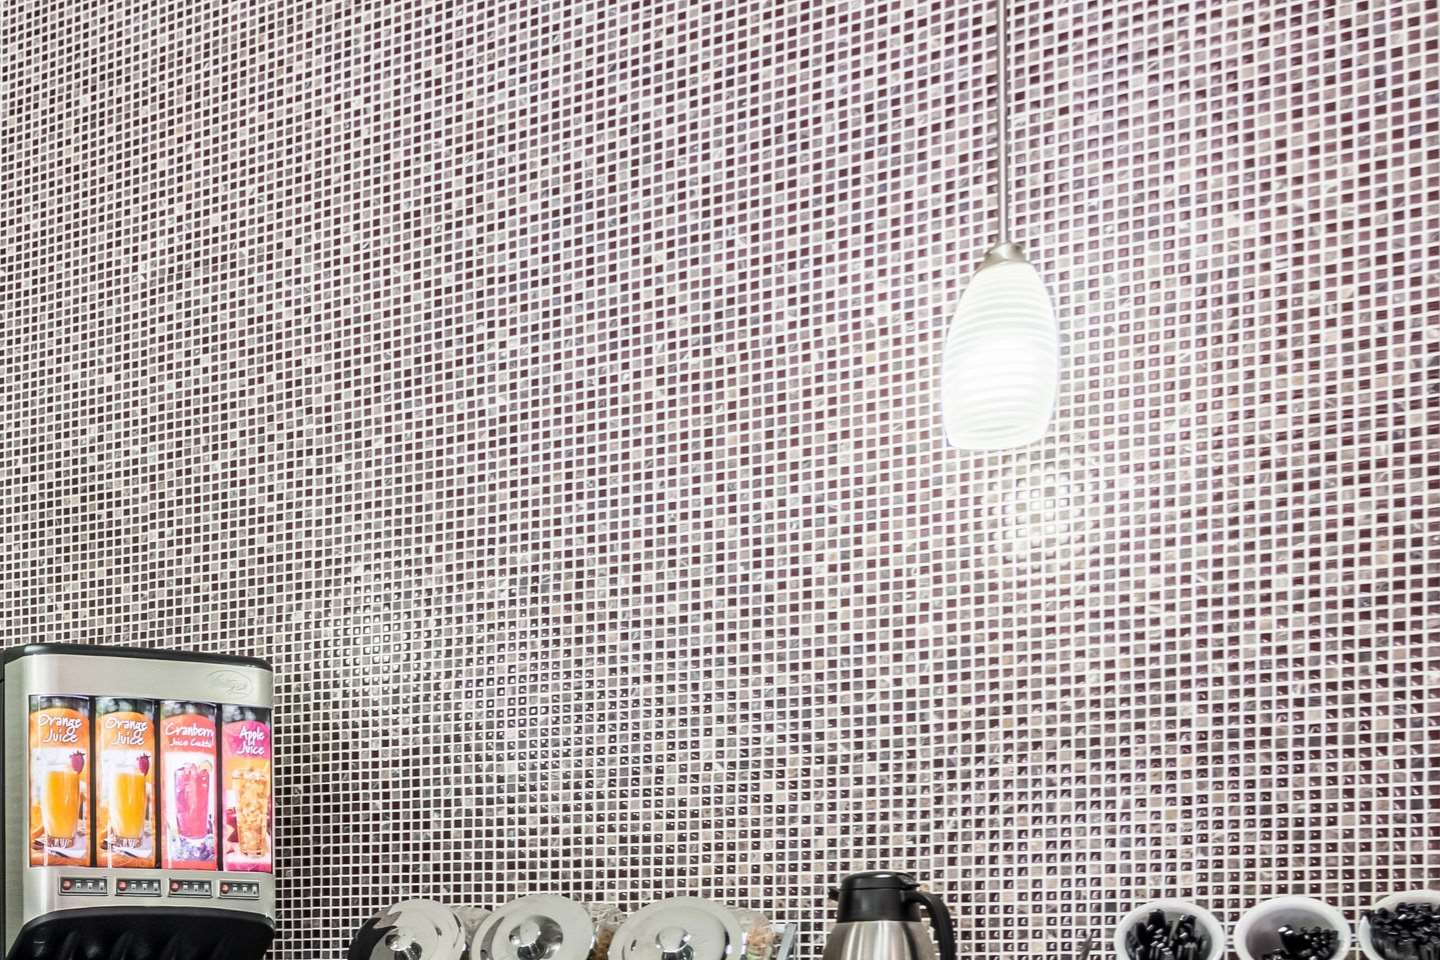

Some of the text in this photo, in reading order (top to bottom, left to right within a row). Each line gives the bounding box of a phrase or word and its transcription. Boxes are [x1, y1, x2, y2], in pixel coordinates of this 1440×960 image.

[38, 714, 82, 736] Orange
[105, 717, 148, 738] Orange
[42, 728, 78, 743] Juice
[111, 731, 145, 745] Juice
[240, 725, 265, 746] Apple
[236, 741, 265, 755] Juice
